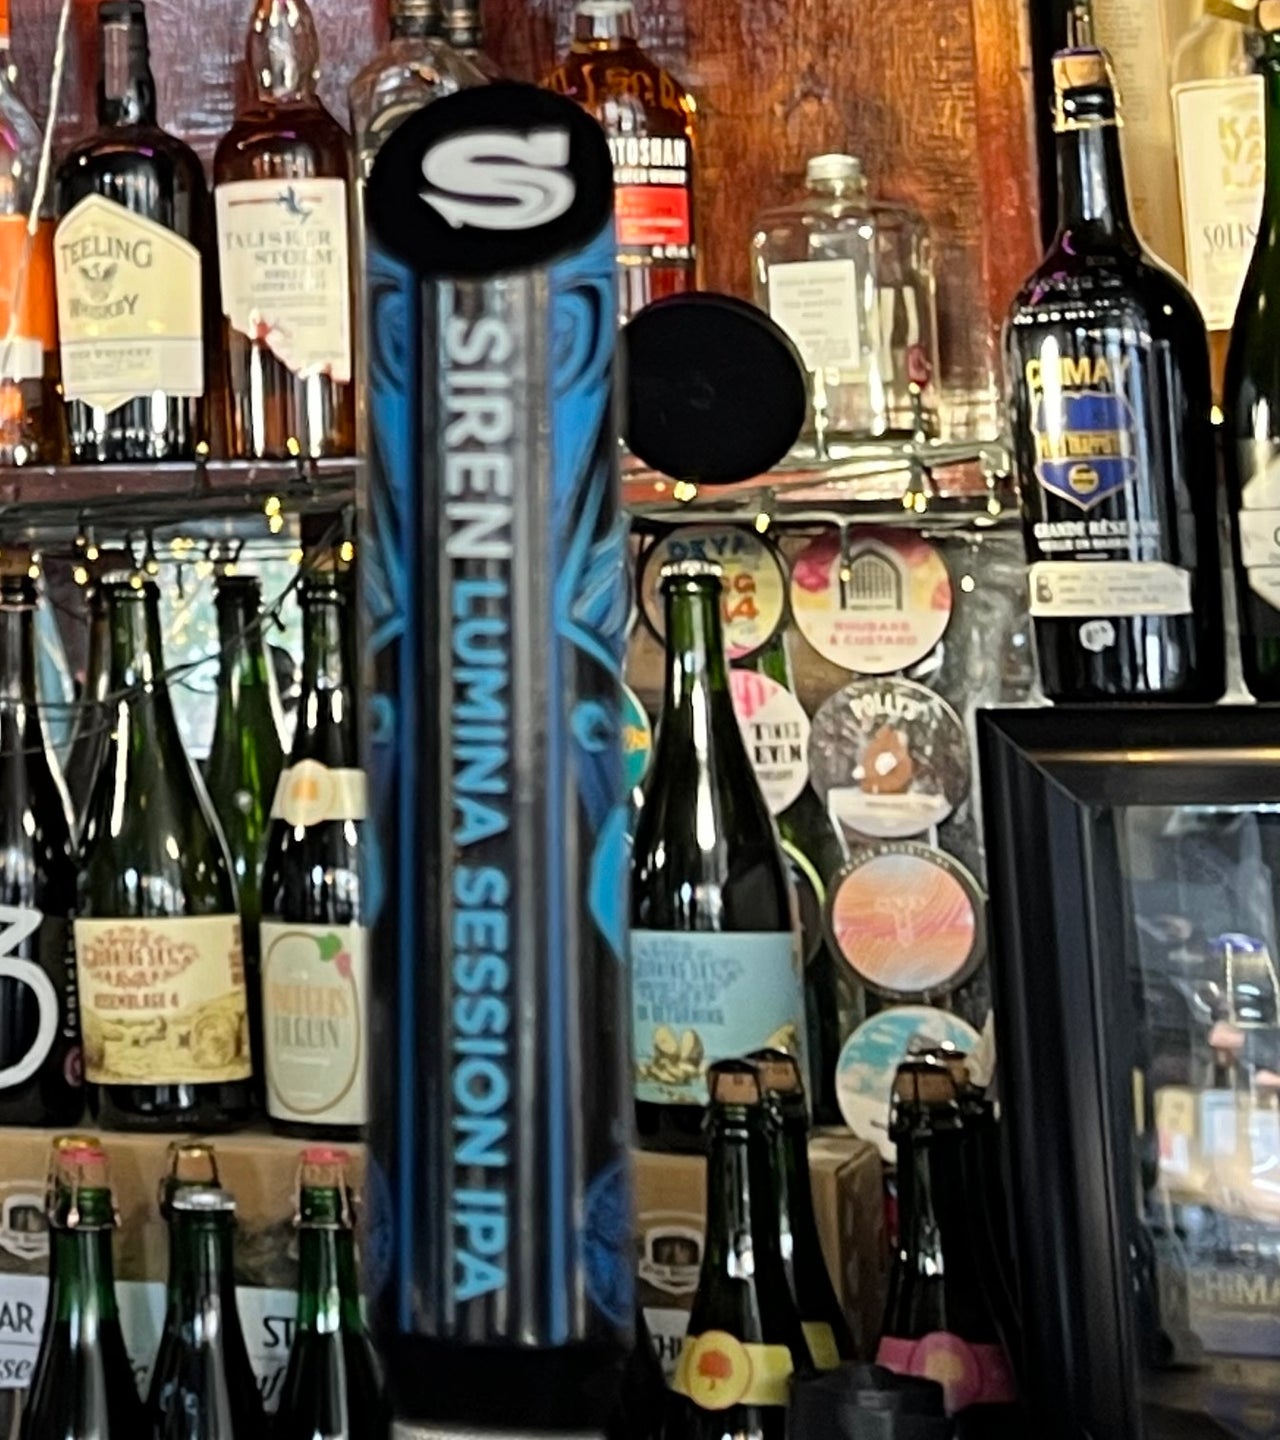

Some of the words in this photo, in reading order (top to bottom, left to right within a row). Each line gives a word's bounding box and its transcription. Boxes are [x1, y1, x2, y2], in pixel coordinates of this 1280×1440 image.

[60, 236, 153, 275] TEELING
[224, 230, 332, 251] TALISKER
[445, 317, 513, 559] SIREN
[834, 621, 911, 632] RHUBARB
[843, 635, 918, 646] CUSTARD
[452, 578, 509, 848] LUMINA
[453, 866, 510, 1168] SESSION
[452, 1188, 509, 1302] IPA
[262, 1315, 296, 1349] ST
